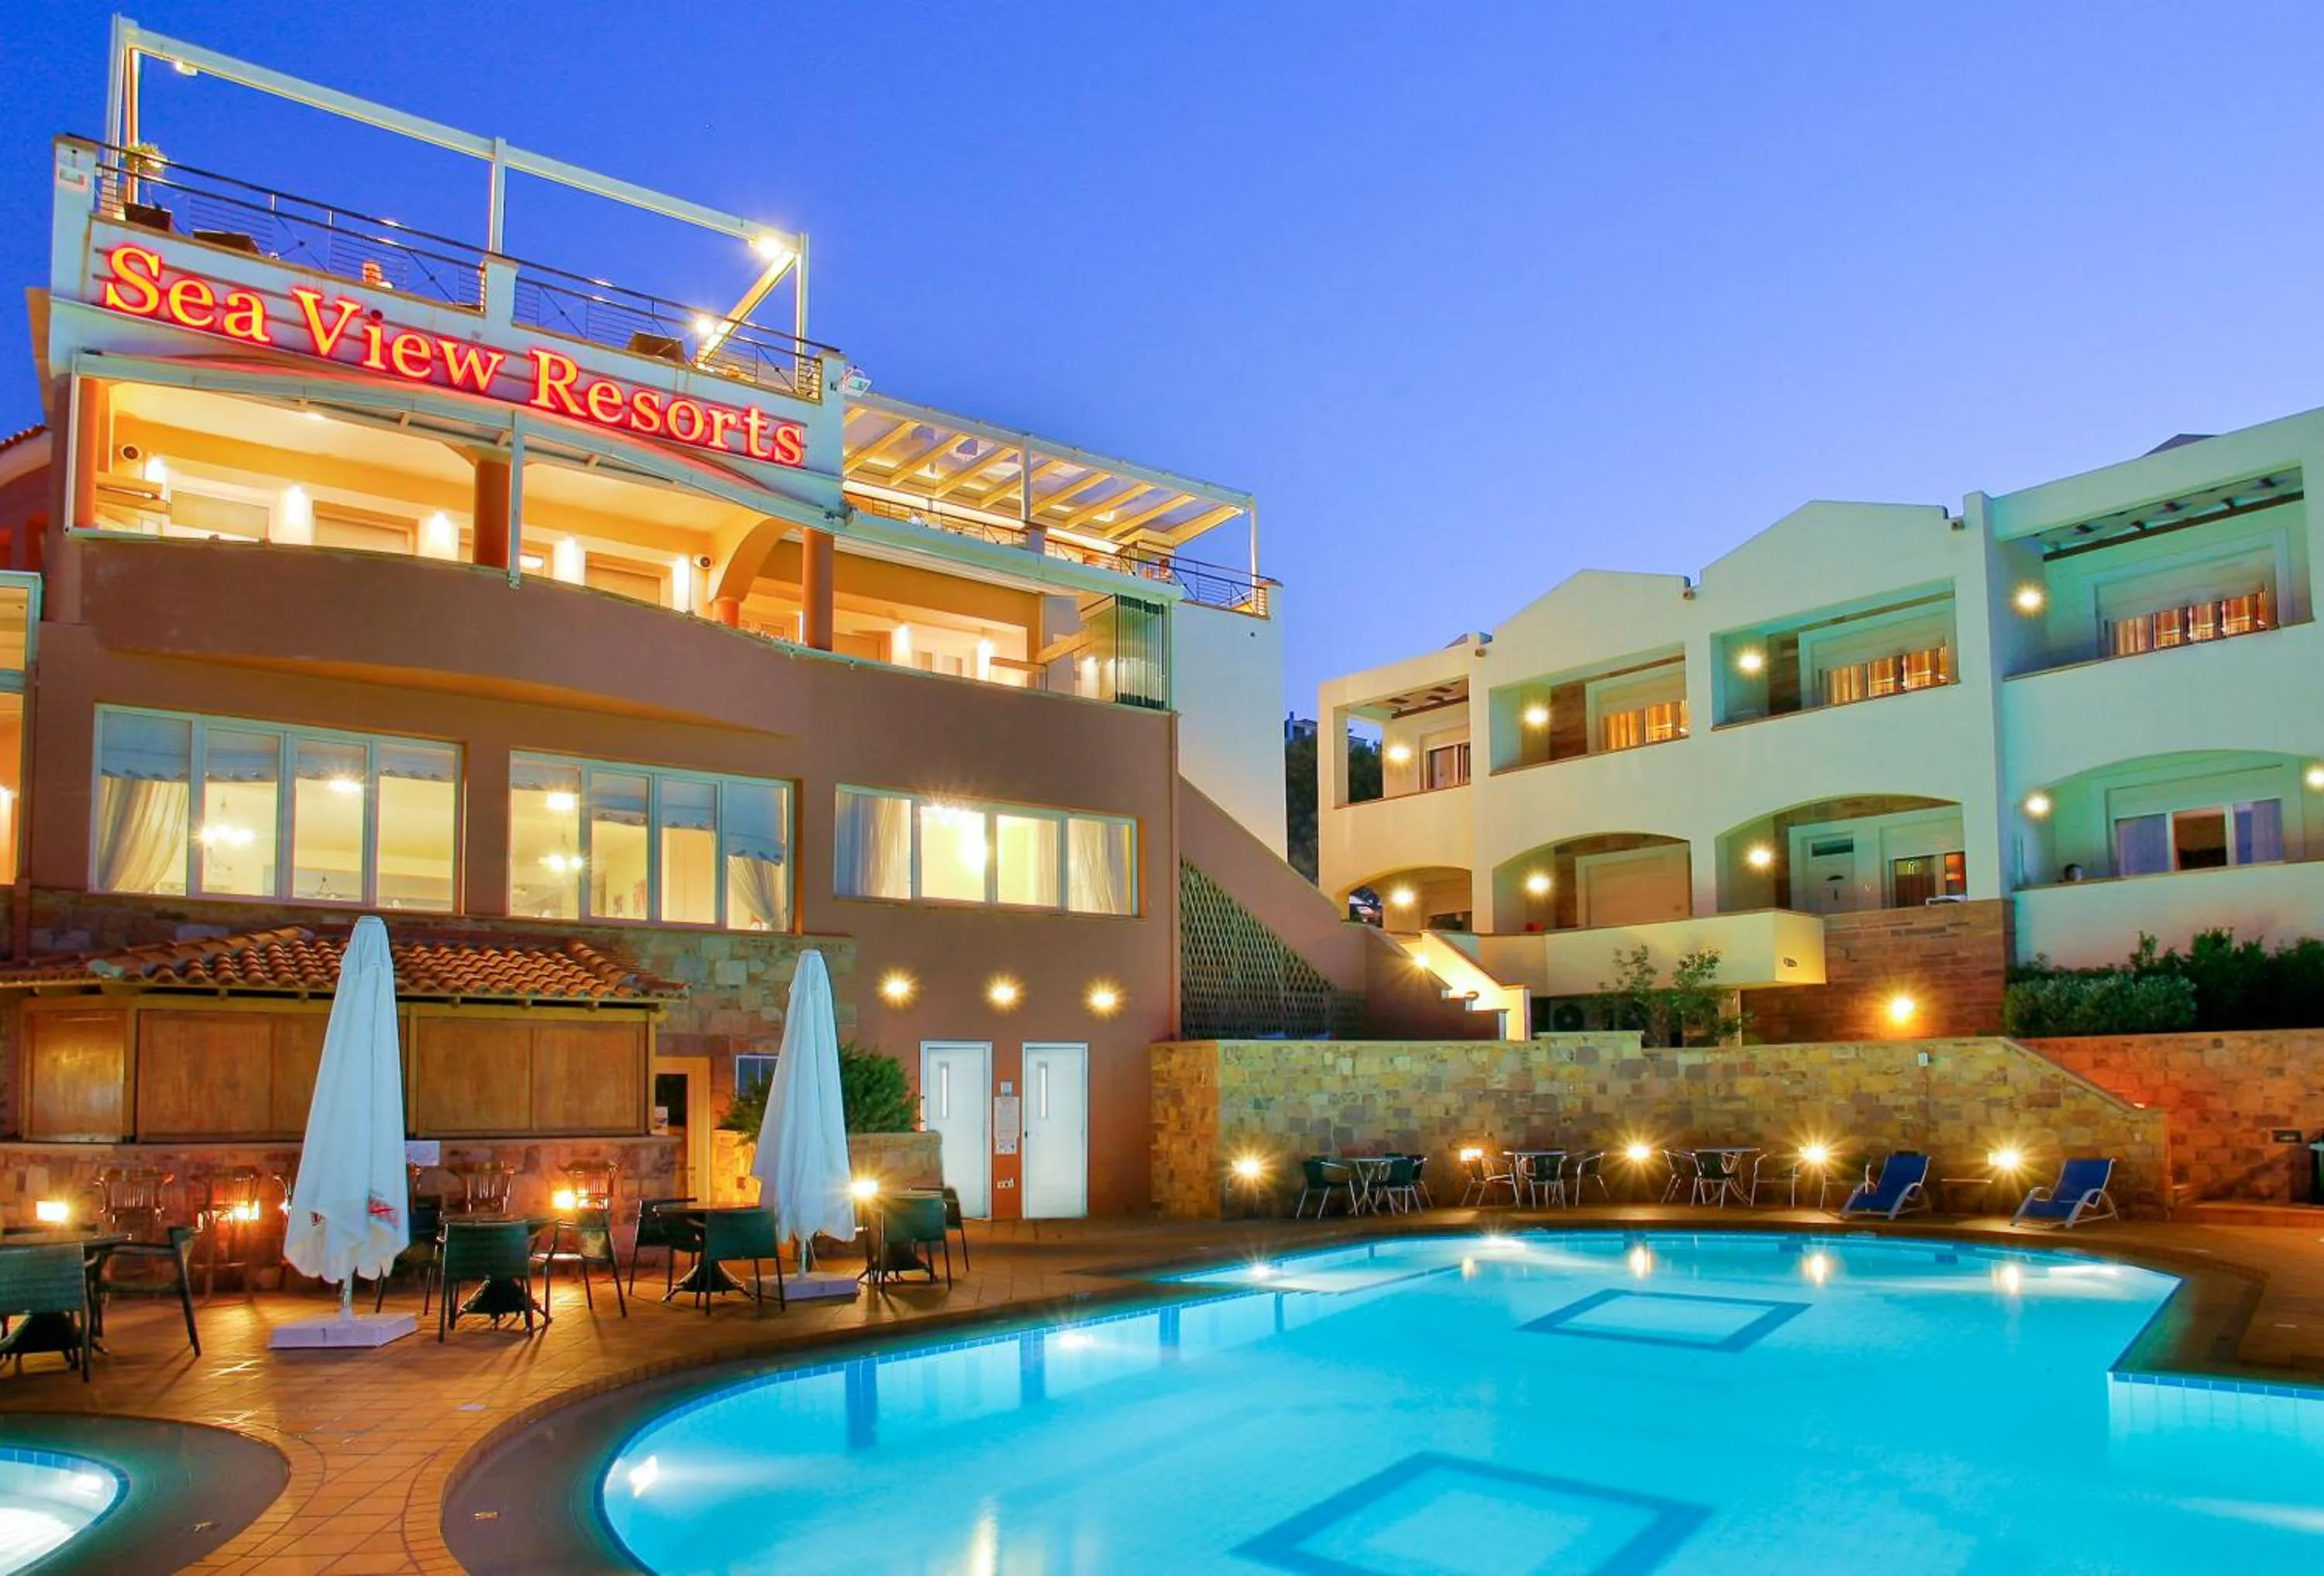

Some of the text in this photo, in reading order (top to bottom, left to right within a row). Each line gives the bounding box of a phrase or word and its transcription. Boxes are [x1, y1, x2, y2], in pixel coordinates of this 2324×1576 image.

[104, 246, 805, 466] Sea View Resorts
